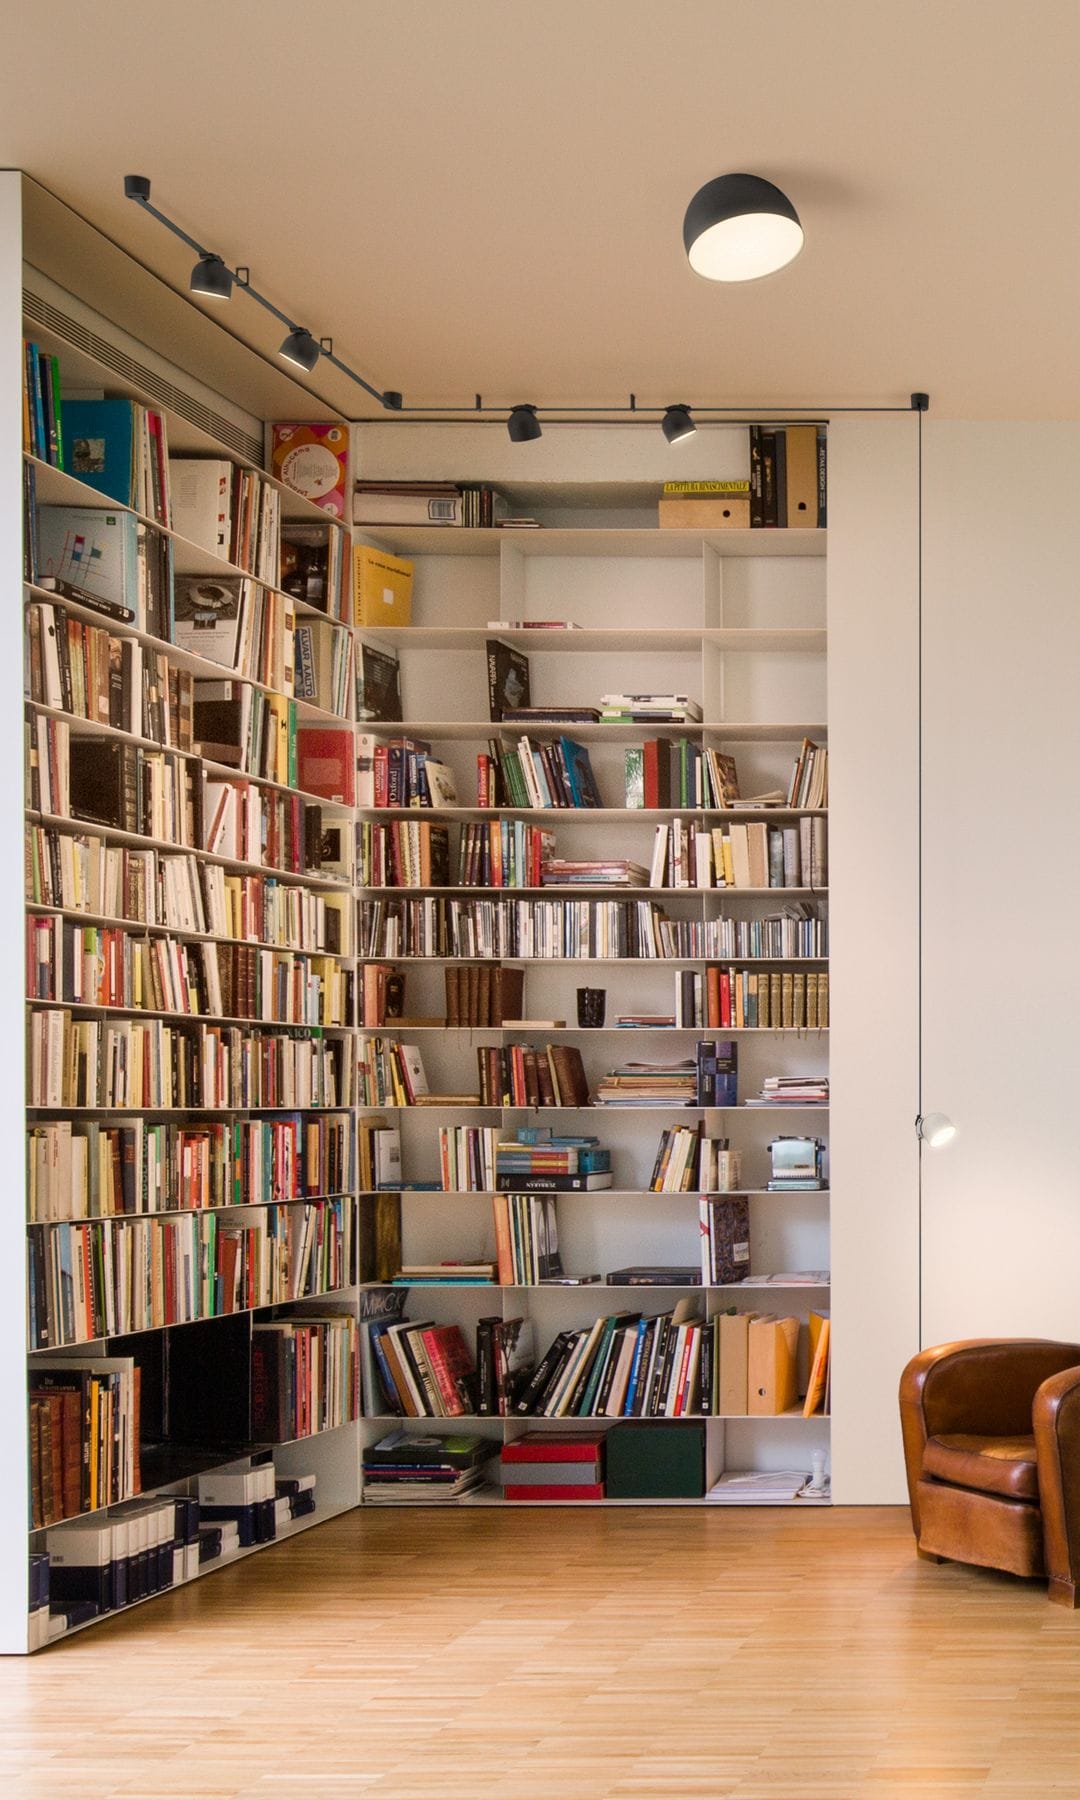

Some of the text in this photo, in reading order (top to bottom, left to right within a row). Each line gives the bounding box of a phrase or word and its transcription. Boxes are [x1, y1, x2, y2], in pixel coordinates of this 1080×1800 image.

[301, 628, 313, 696] ALVAR AALTO
[389, 770, 398, 801] Oxford
